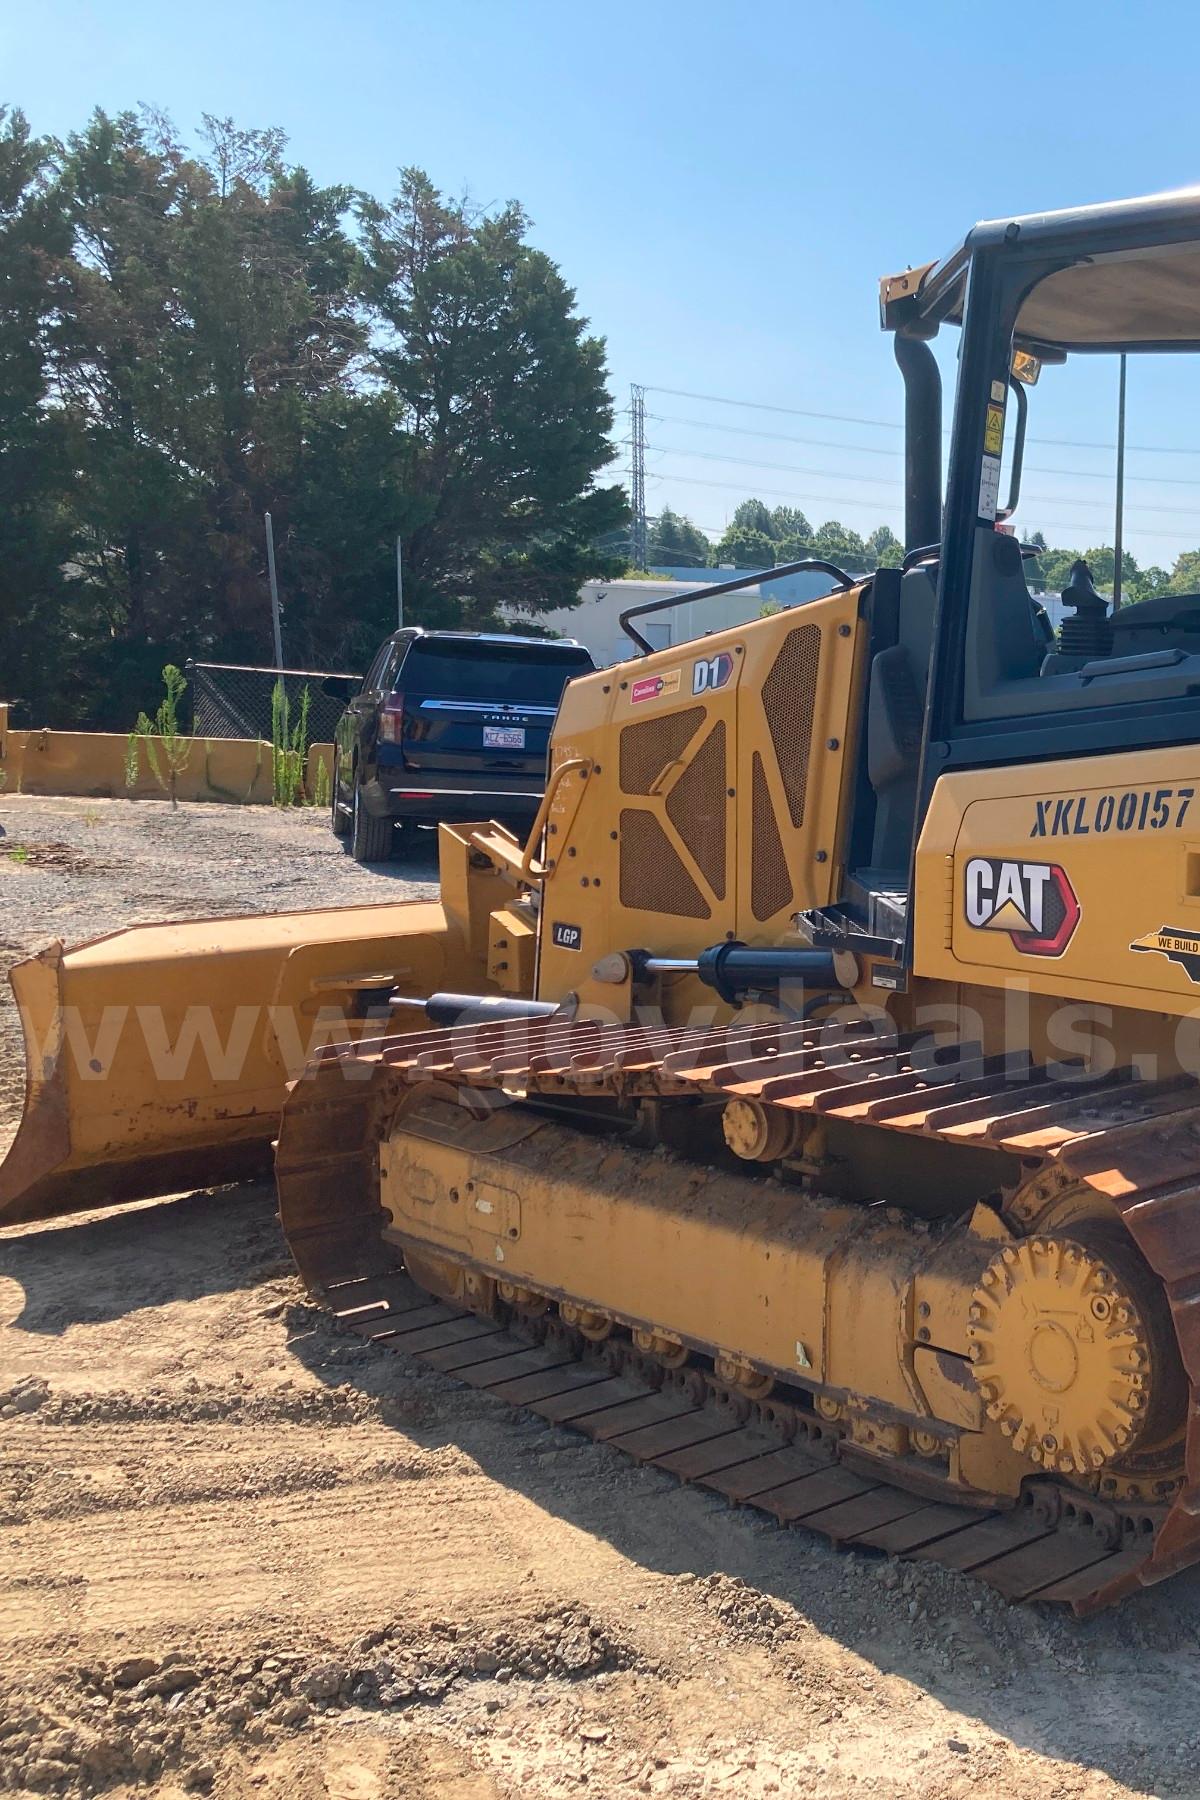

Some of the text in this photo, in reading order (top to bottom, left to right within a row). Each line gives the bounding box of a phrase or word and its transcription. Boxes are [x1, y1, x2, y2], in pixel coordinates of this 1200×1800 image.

[693, 656, 720, 694] D1
[966, 858, 1051, 934] CAT
[557, 927, 578, 945] LGP
[1158, 937, 1172, 949] WE
[1174, 939, 1199, 953] BUILD
